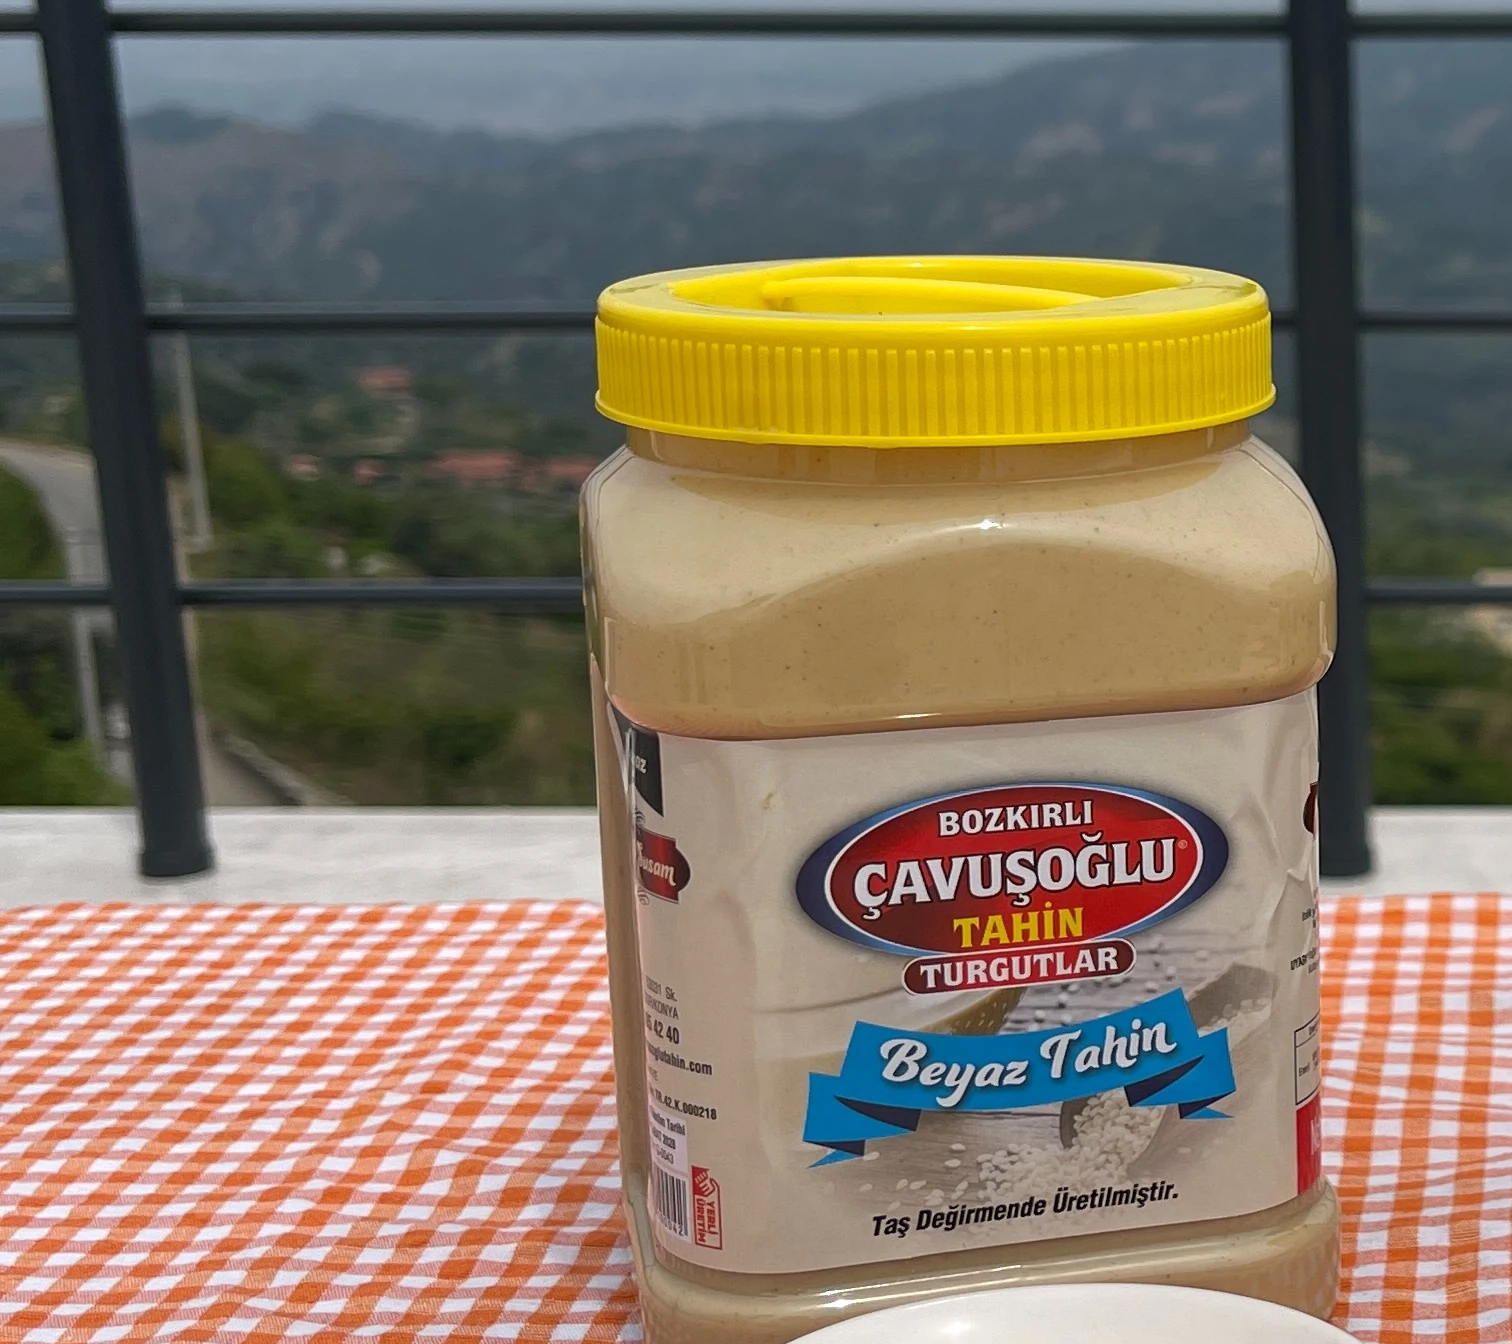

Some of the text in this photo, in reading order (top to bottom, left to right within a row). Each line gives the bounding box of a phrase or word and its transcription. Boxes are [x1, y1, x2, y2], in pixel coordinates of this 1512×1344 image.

[938, 800, 1093, 837] BOZKIRLI
[853, 832, 1176, 921] ÇAVUŞOĞLU
[953, 901, 1084, 948] TAHİN
[920, 946, 1119, 989] TURGUTLAR
[666, 1026, 679, 1045] 40
[879, 1018, 1177, 1107] Beyaz Tahin
[872, 1180, 1180, 1239] Taş Değirmende Üretilmiştir.
